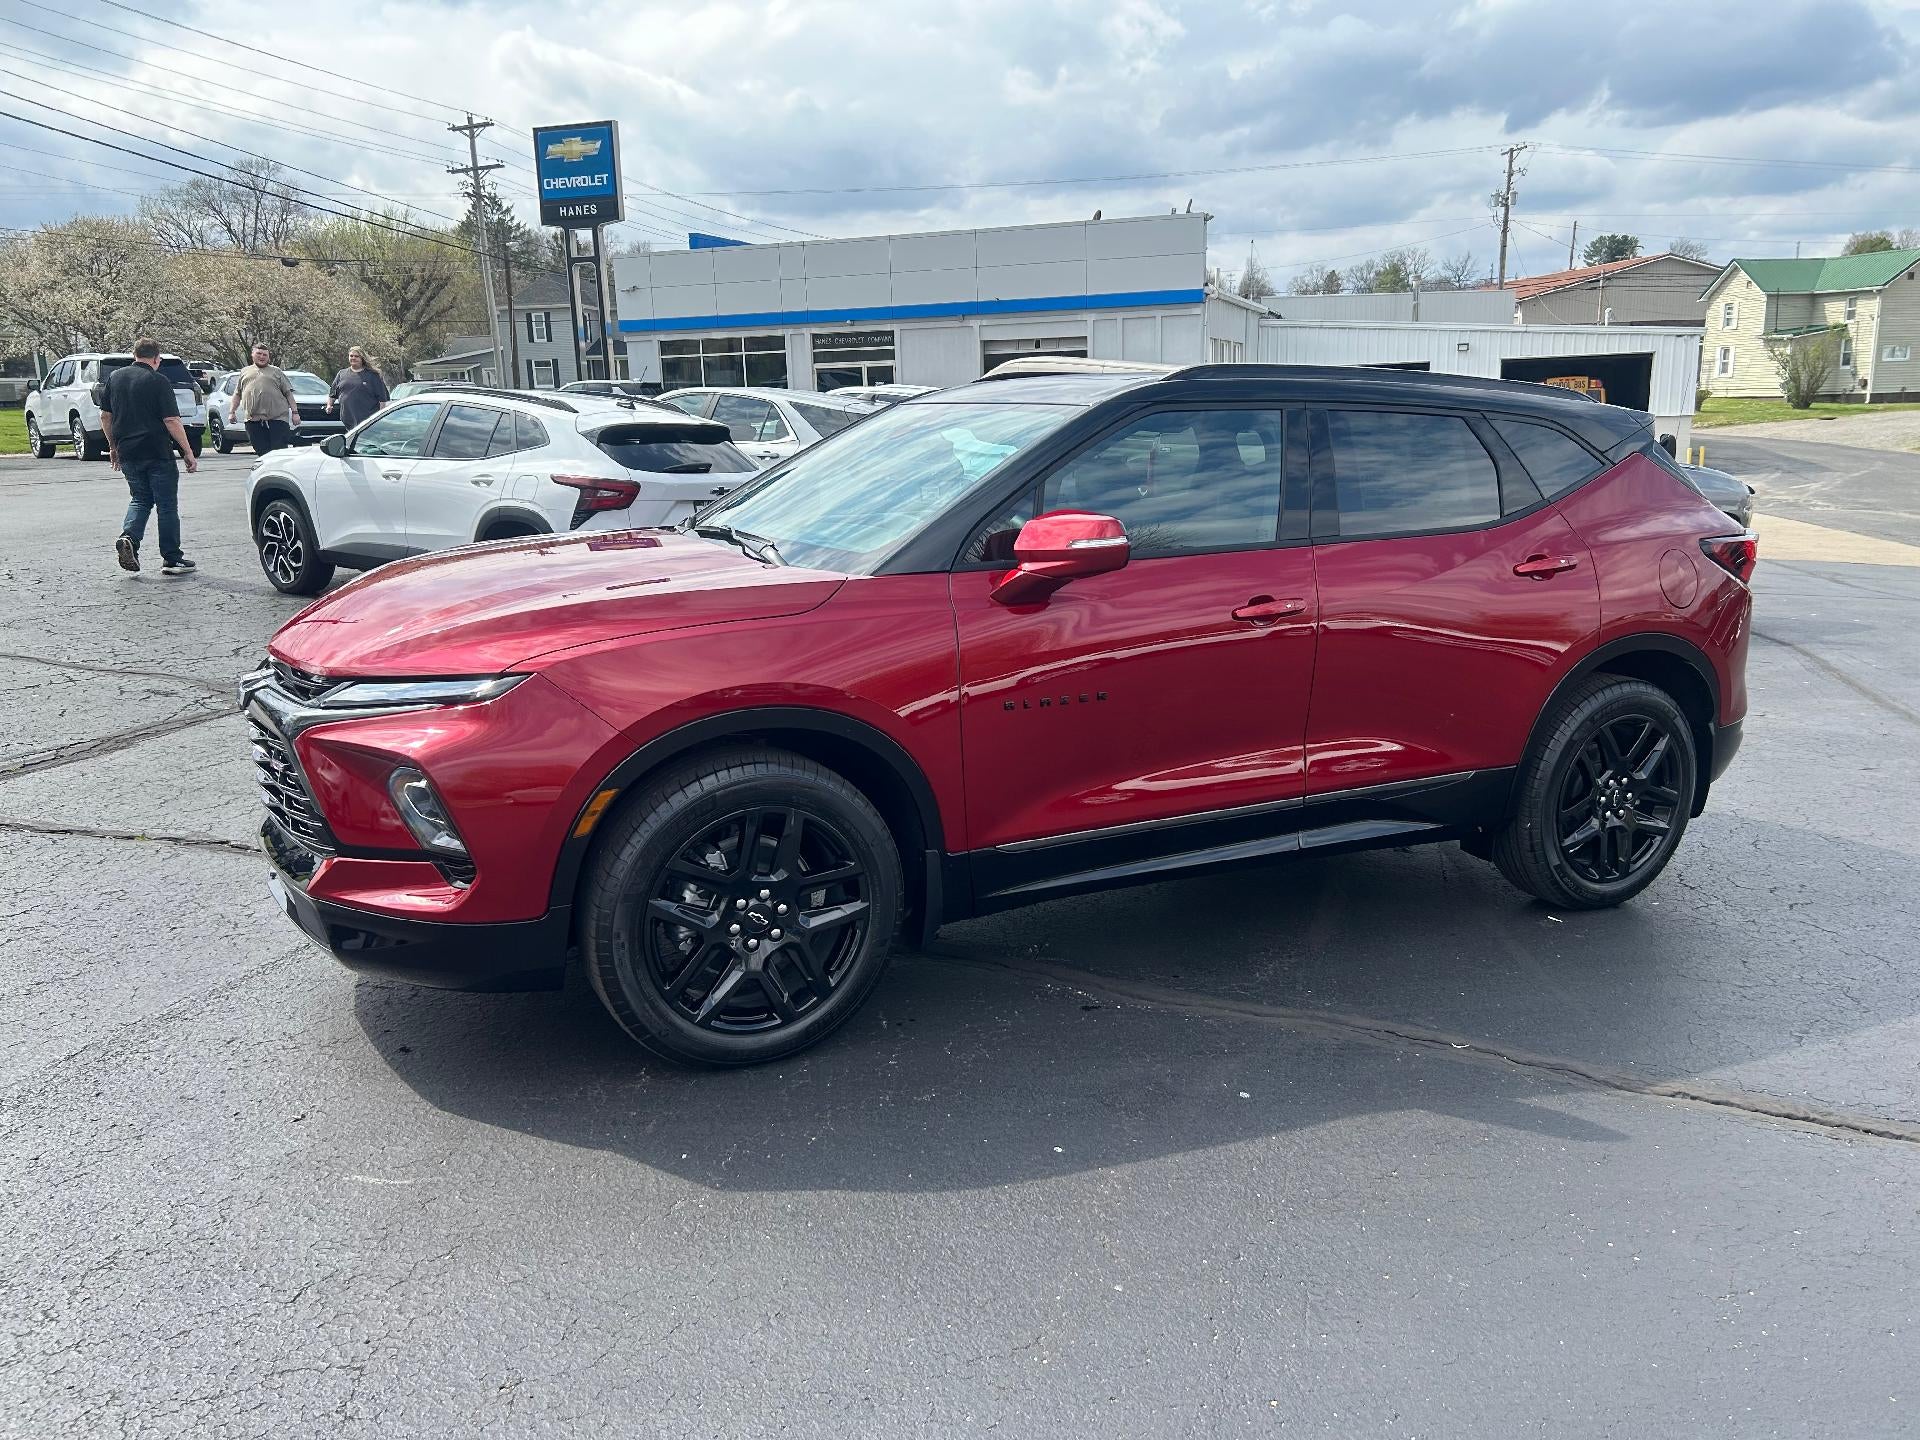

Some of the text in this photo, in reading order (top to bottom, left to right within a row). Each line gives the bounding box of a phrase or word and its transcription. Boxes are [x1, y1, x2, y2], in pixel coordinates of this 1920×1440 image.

[543, 173, 609, 190] CHEVROLET
[559, 203, 598, 217] HANES
[834, 336, 865, 345] CHEVROLET
[1003, 691, 1108, 711] BLAZER
